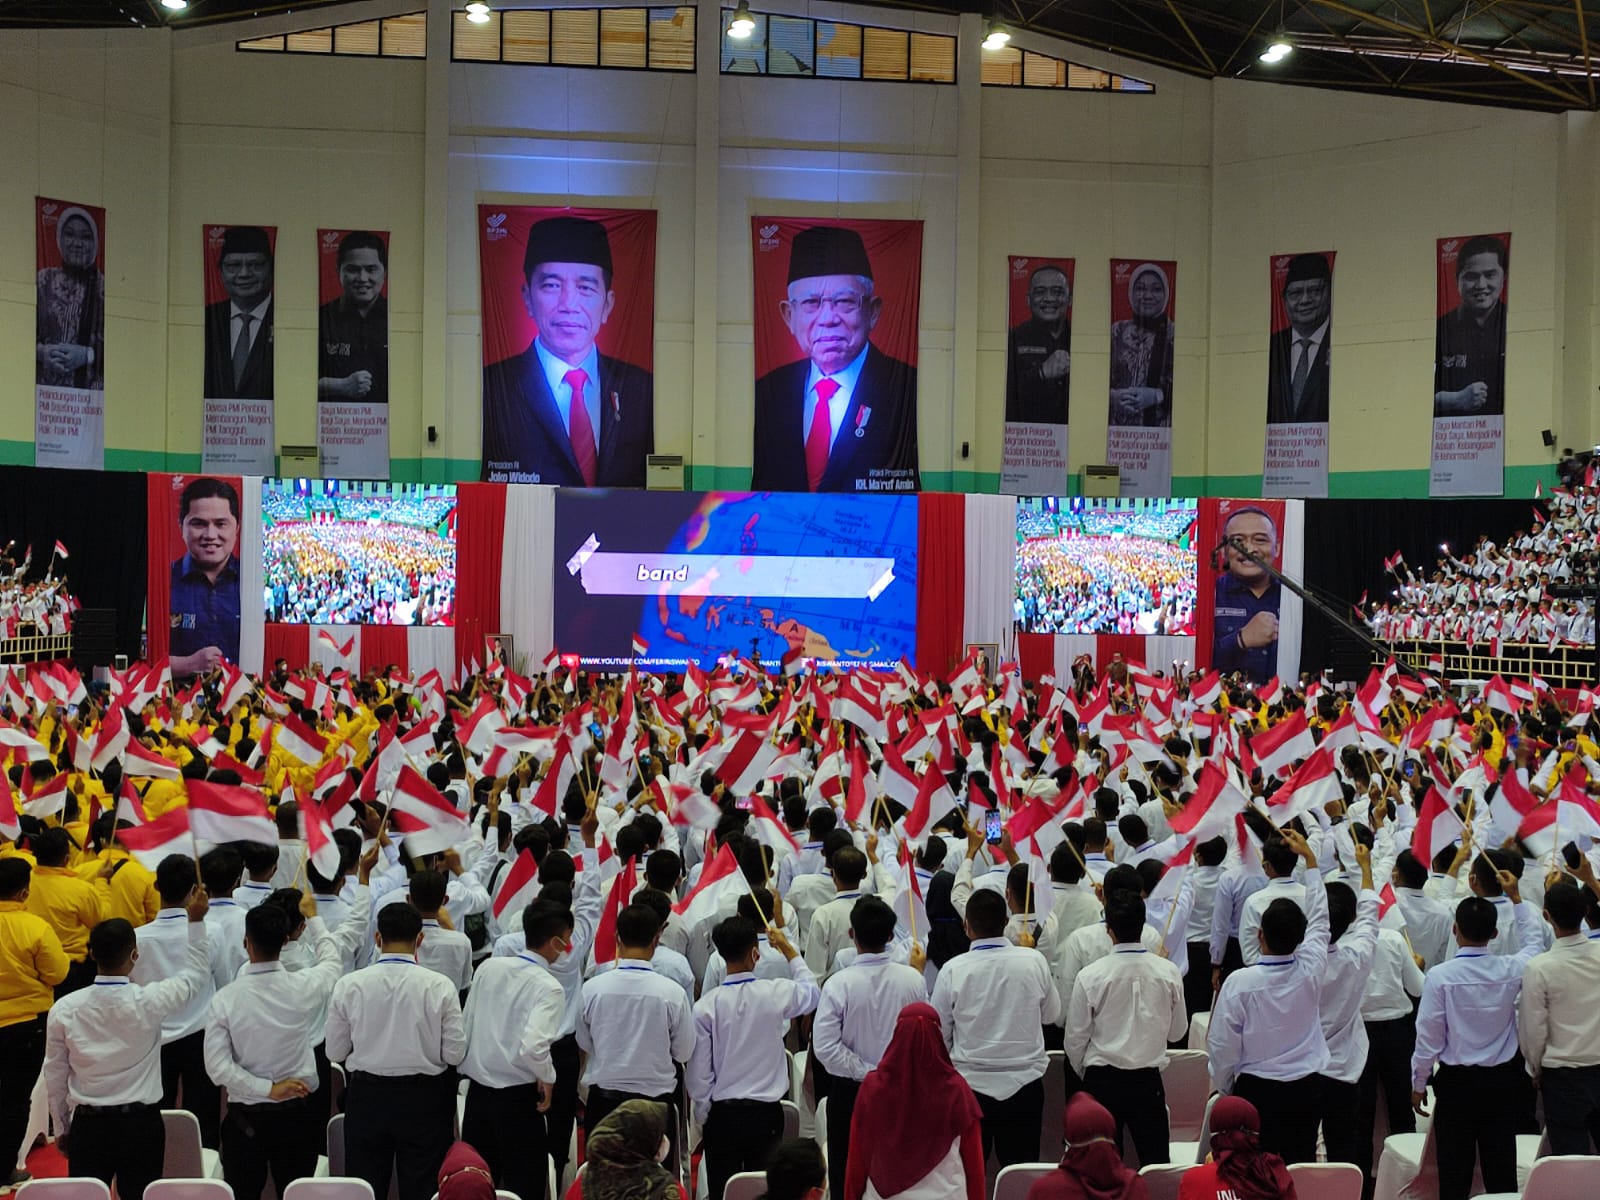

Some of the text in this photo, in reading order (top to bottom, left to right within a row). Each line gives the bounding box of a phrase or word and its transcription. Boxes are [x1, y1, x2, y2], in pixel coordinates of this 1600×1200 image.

[488, 472, 540, 482] Joko Widodo
[895, 479, 914, 489] Amin
[637, 565, 689, 582] band
